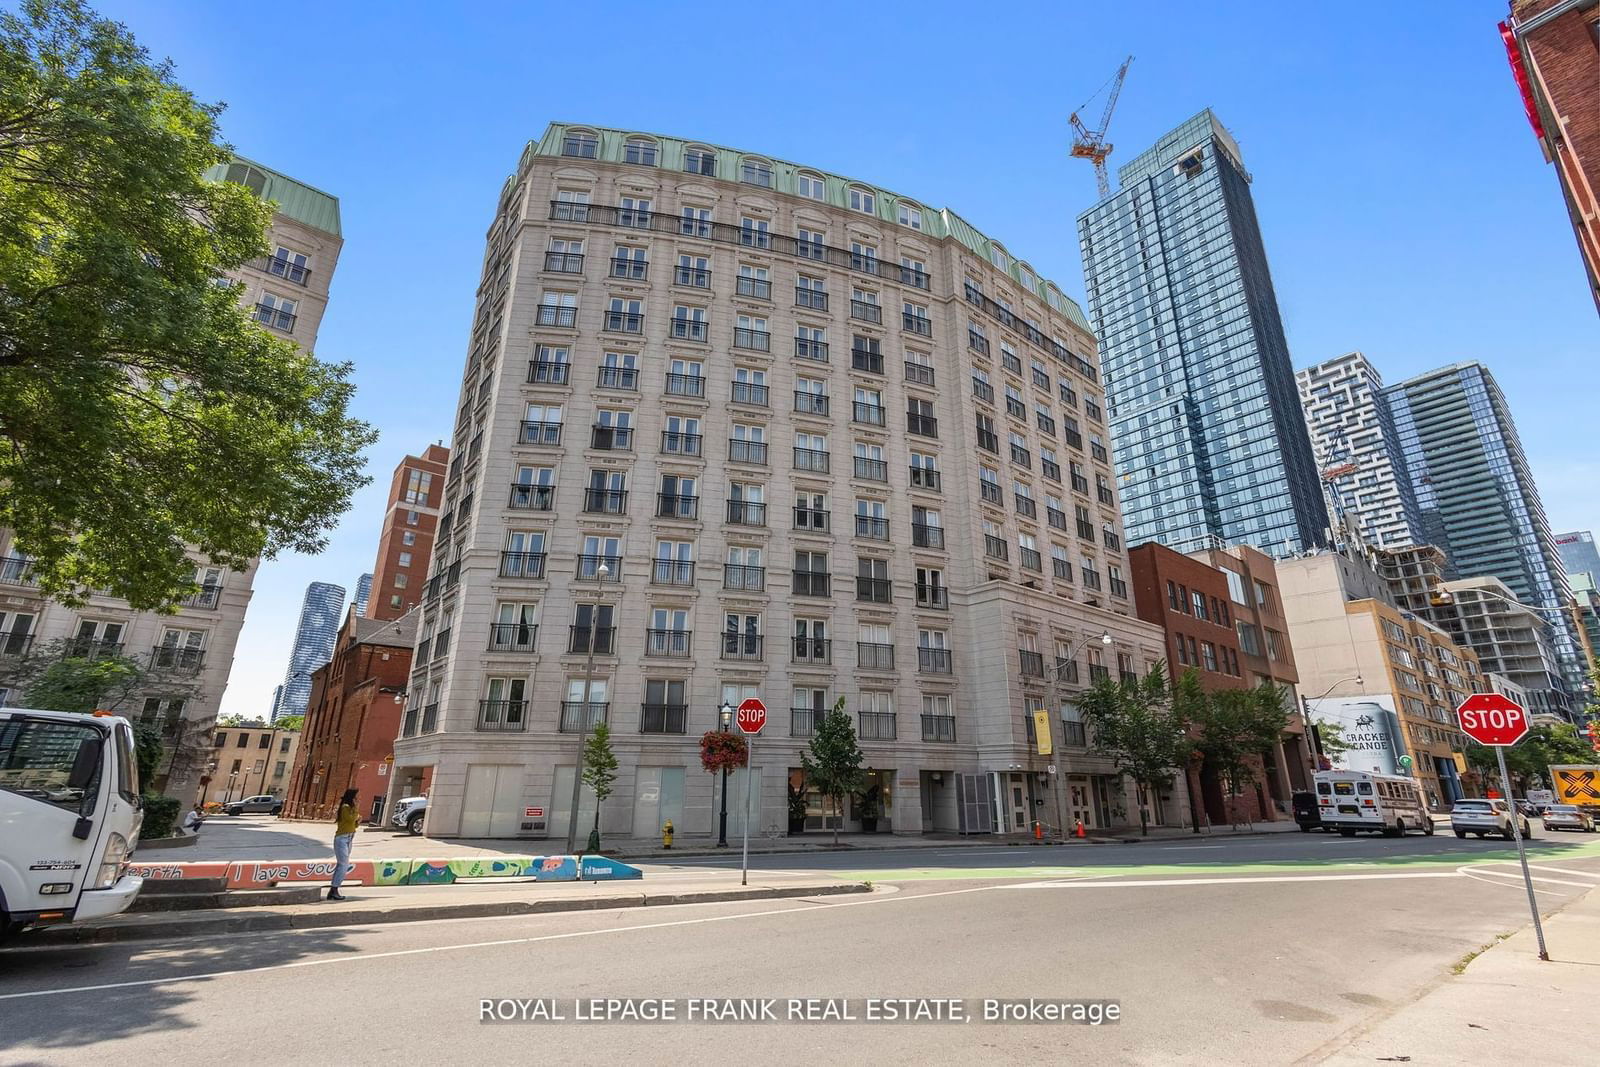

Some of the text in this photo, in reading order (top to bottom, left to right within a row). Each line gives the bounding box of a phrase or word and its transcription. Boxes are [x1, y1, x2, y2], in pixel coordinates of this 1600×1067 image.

[739, 709, 764, 723] STOP
[1463, 709, 1520, 729] STOP
[1353, 741, 1388, 751] CANOE
[127, 864, 183, 879] earth
